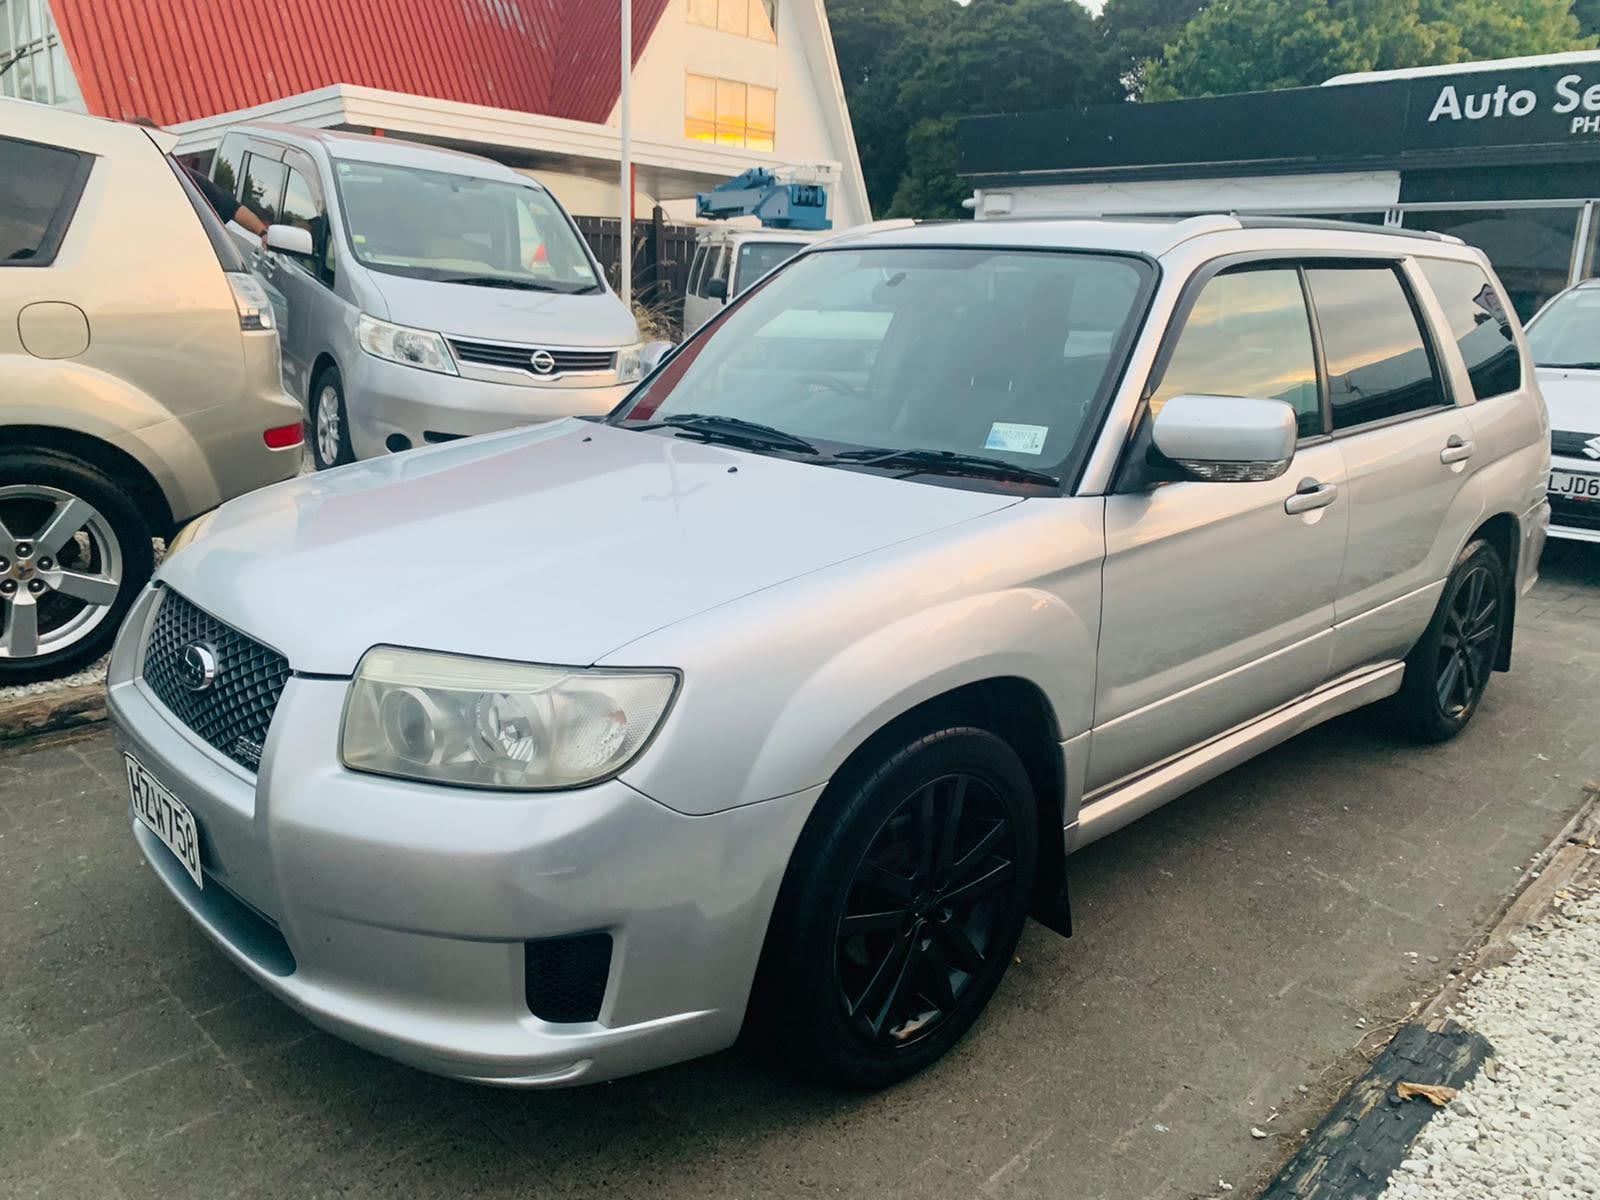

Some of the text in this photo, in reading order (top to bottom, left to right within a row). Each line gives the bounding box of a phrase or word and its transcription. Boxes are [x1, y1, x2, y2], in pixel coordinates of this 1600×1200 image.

[1428, 85, 1537, 121] Auto
[1548, 474, 1600, 496] LJD6
[129, 766, 197, 872] HZW758
